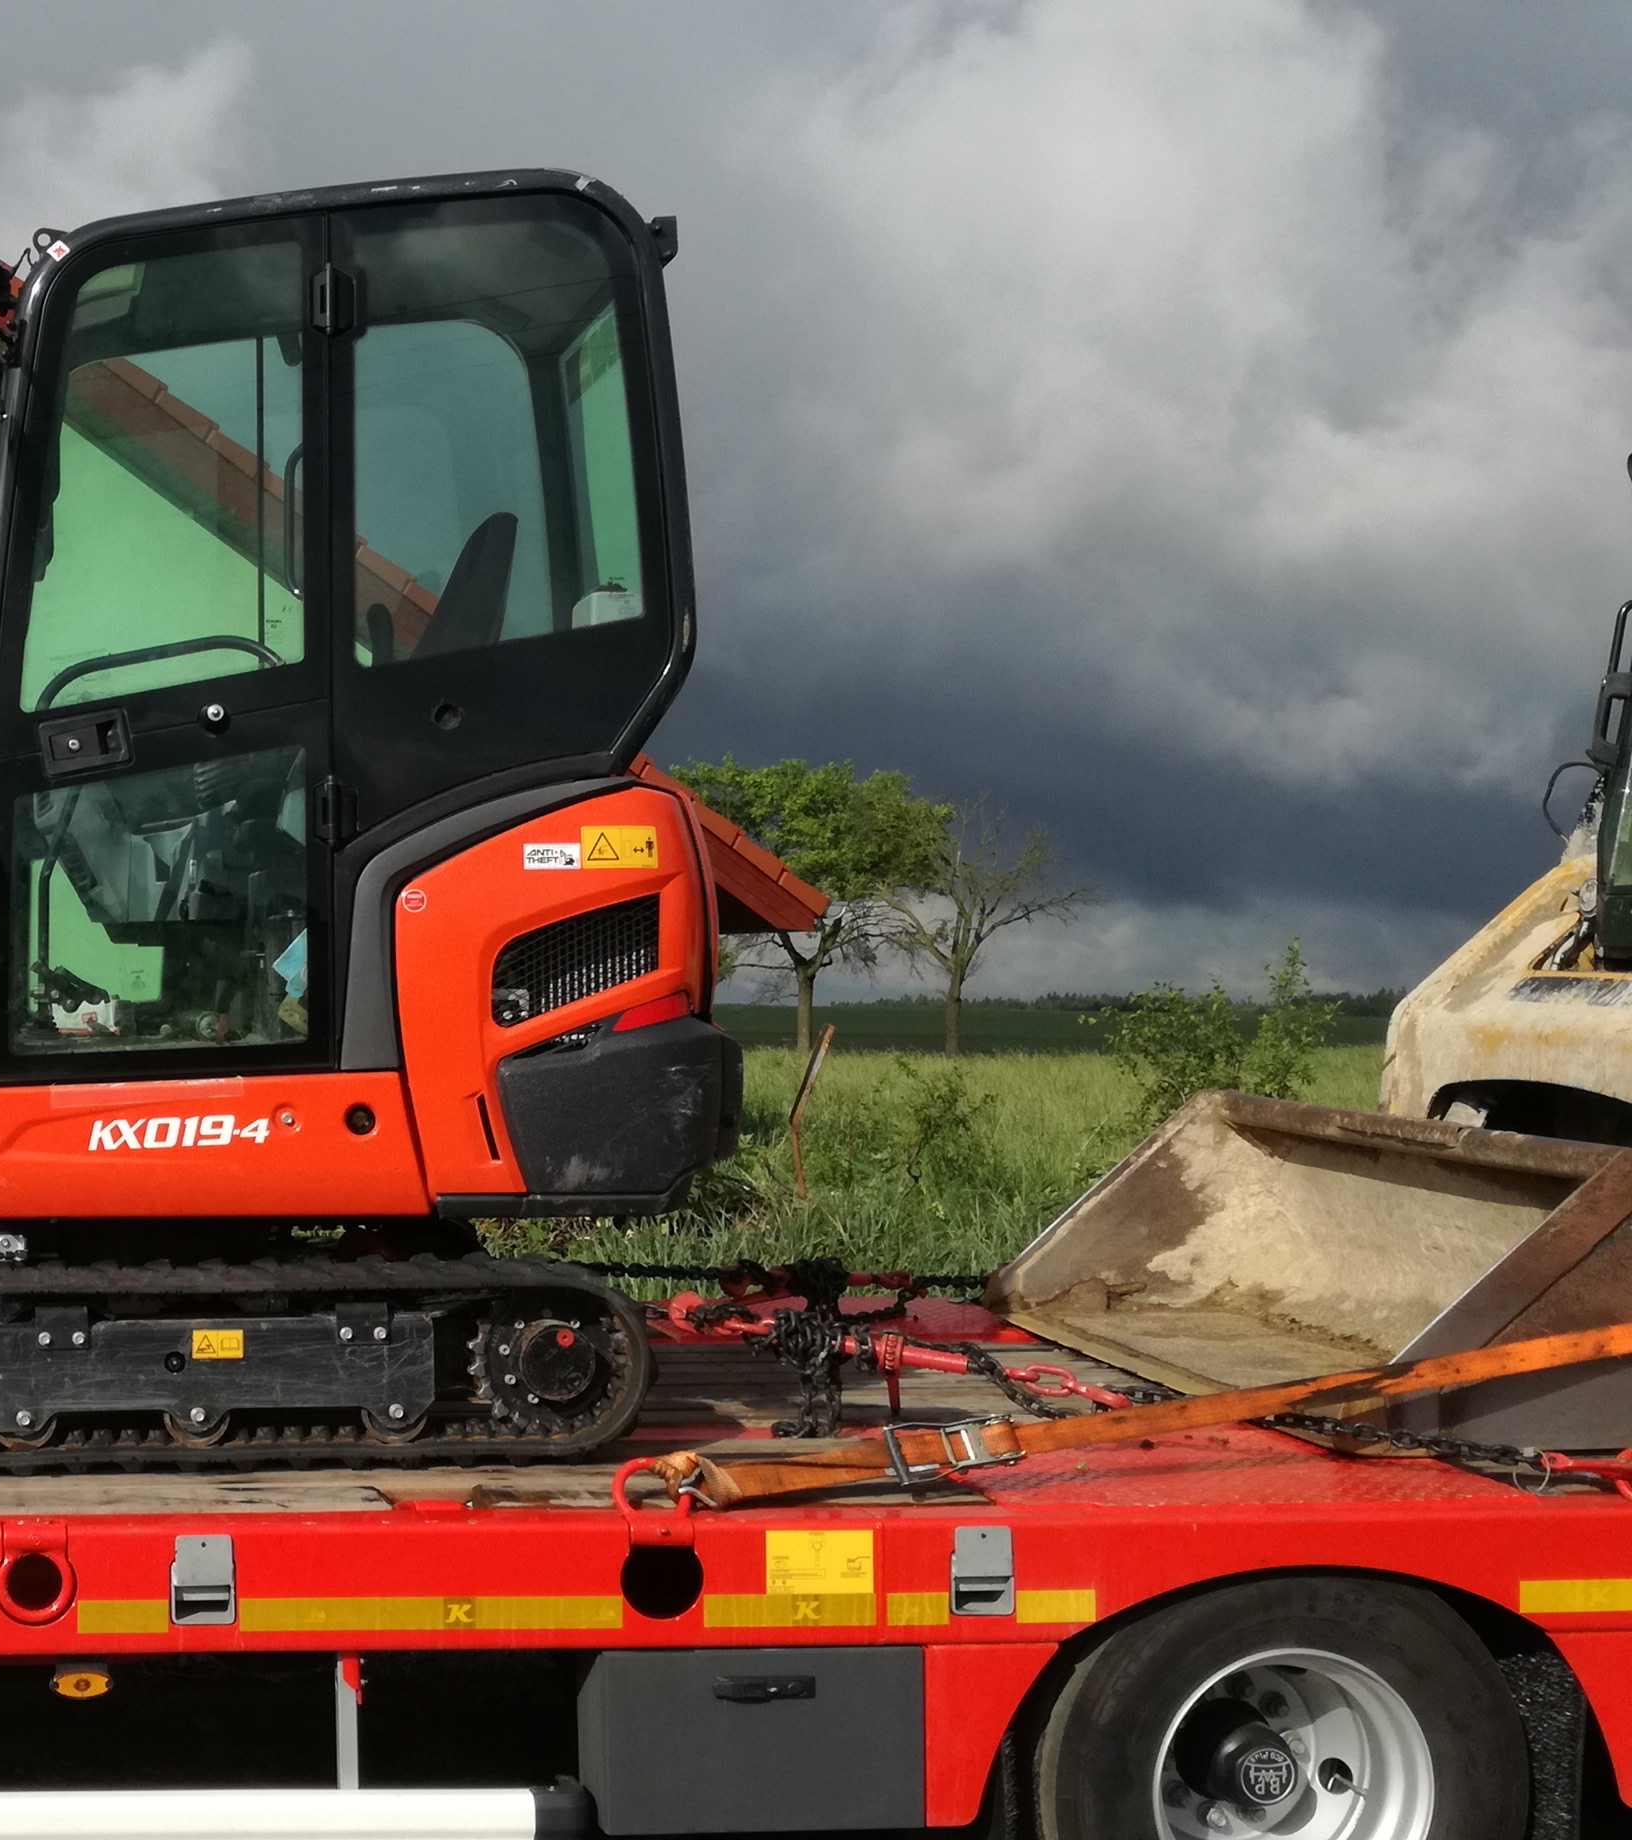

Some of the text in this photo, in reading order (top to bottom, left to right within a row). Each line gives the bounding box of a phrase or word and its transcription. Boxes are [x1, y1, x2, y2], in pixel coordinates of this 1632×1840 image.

[525, 856, 559, 864] THEFT
[87, 1114, 270, 1151] KX019-4
[445, 1604, 474, 1623] K
[794, 1601, 822, 1620] K
